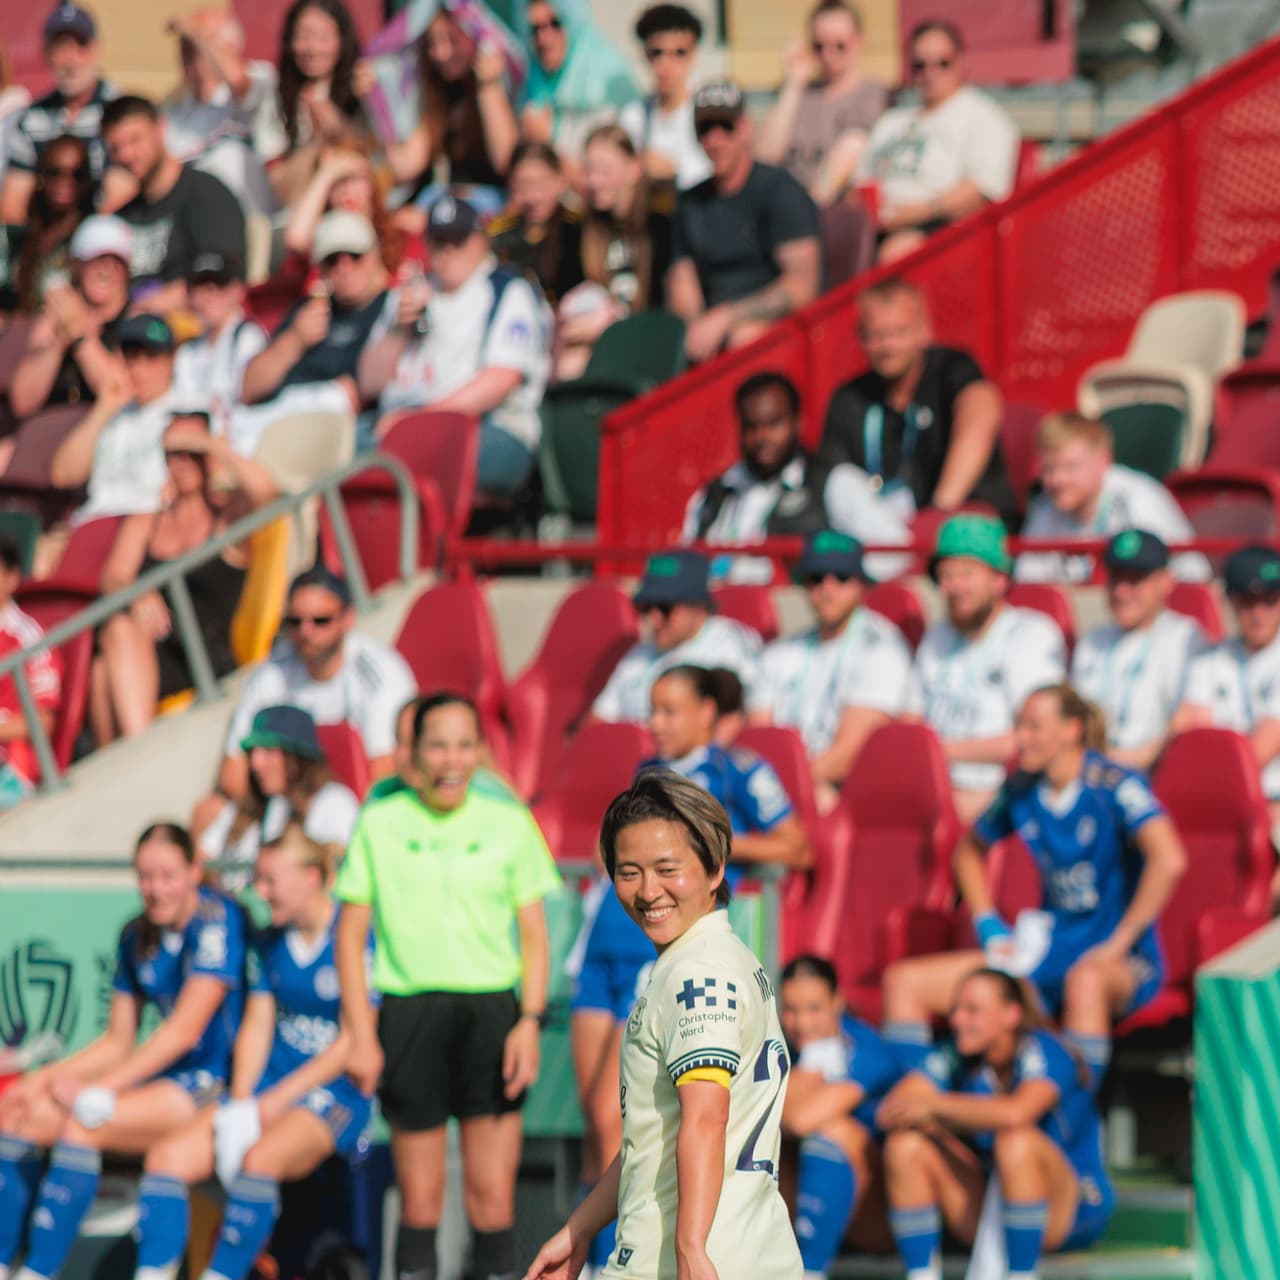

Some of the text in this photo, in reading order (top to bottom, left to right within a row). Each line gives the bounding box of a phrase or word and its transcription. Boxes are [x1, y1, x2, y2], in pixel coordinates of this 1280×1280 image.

[678, 1012, 737, 1028] Christopher
[680, 1025, 705, 1040] Ward
[735, 1039, 789, 1182] 2
